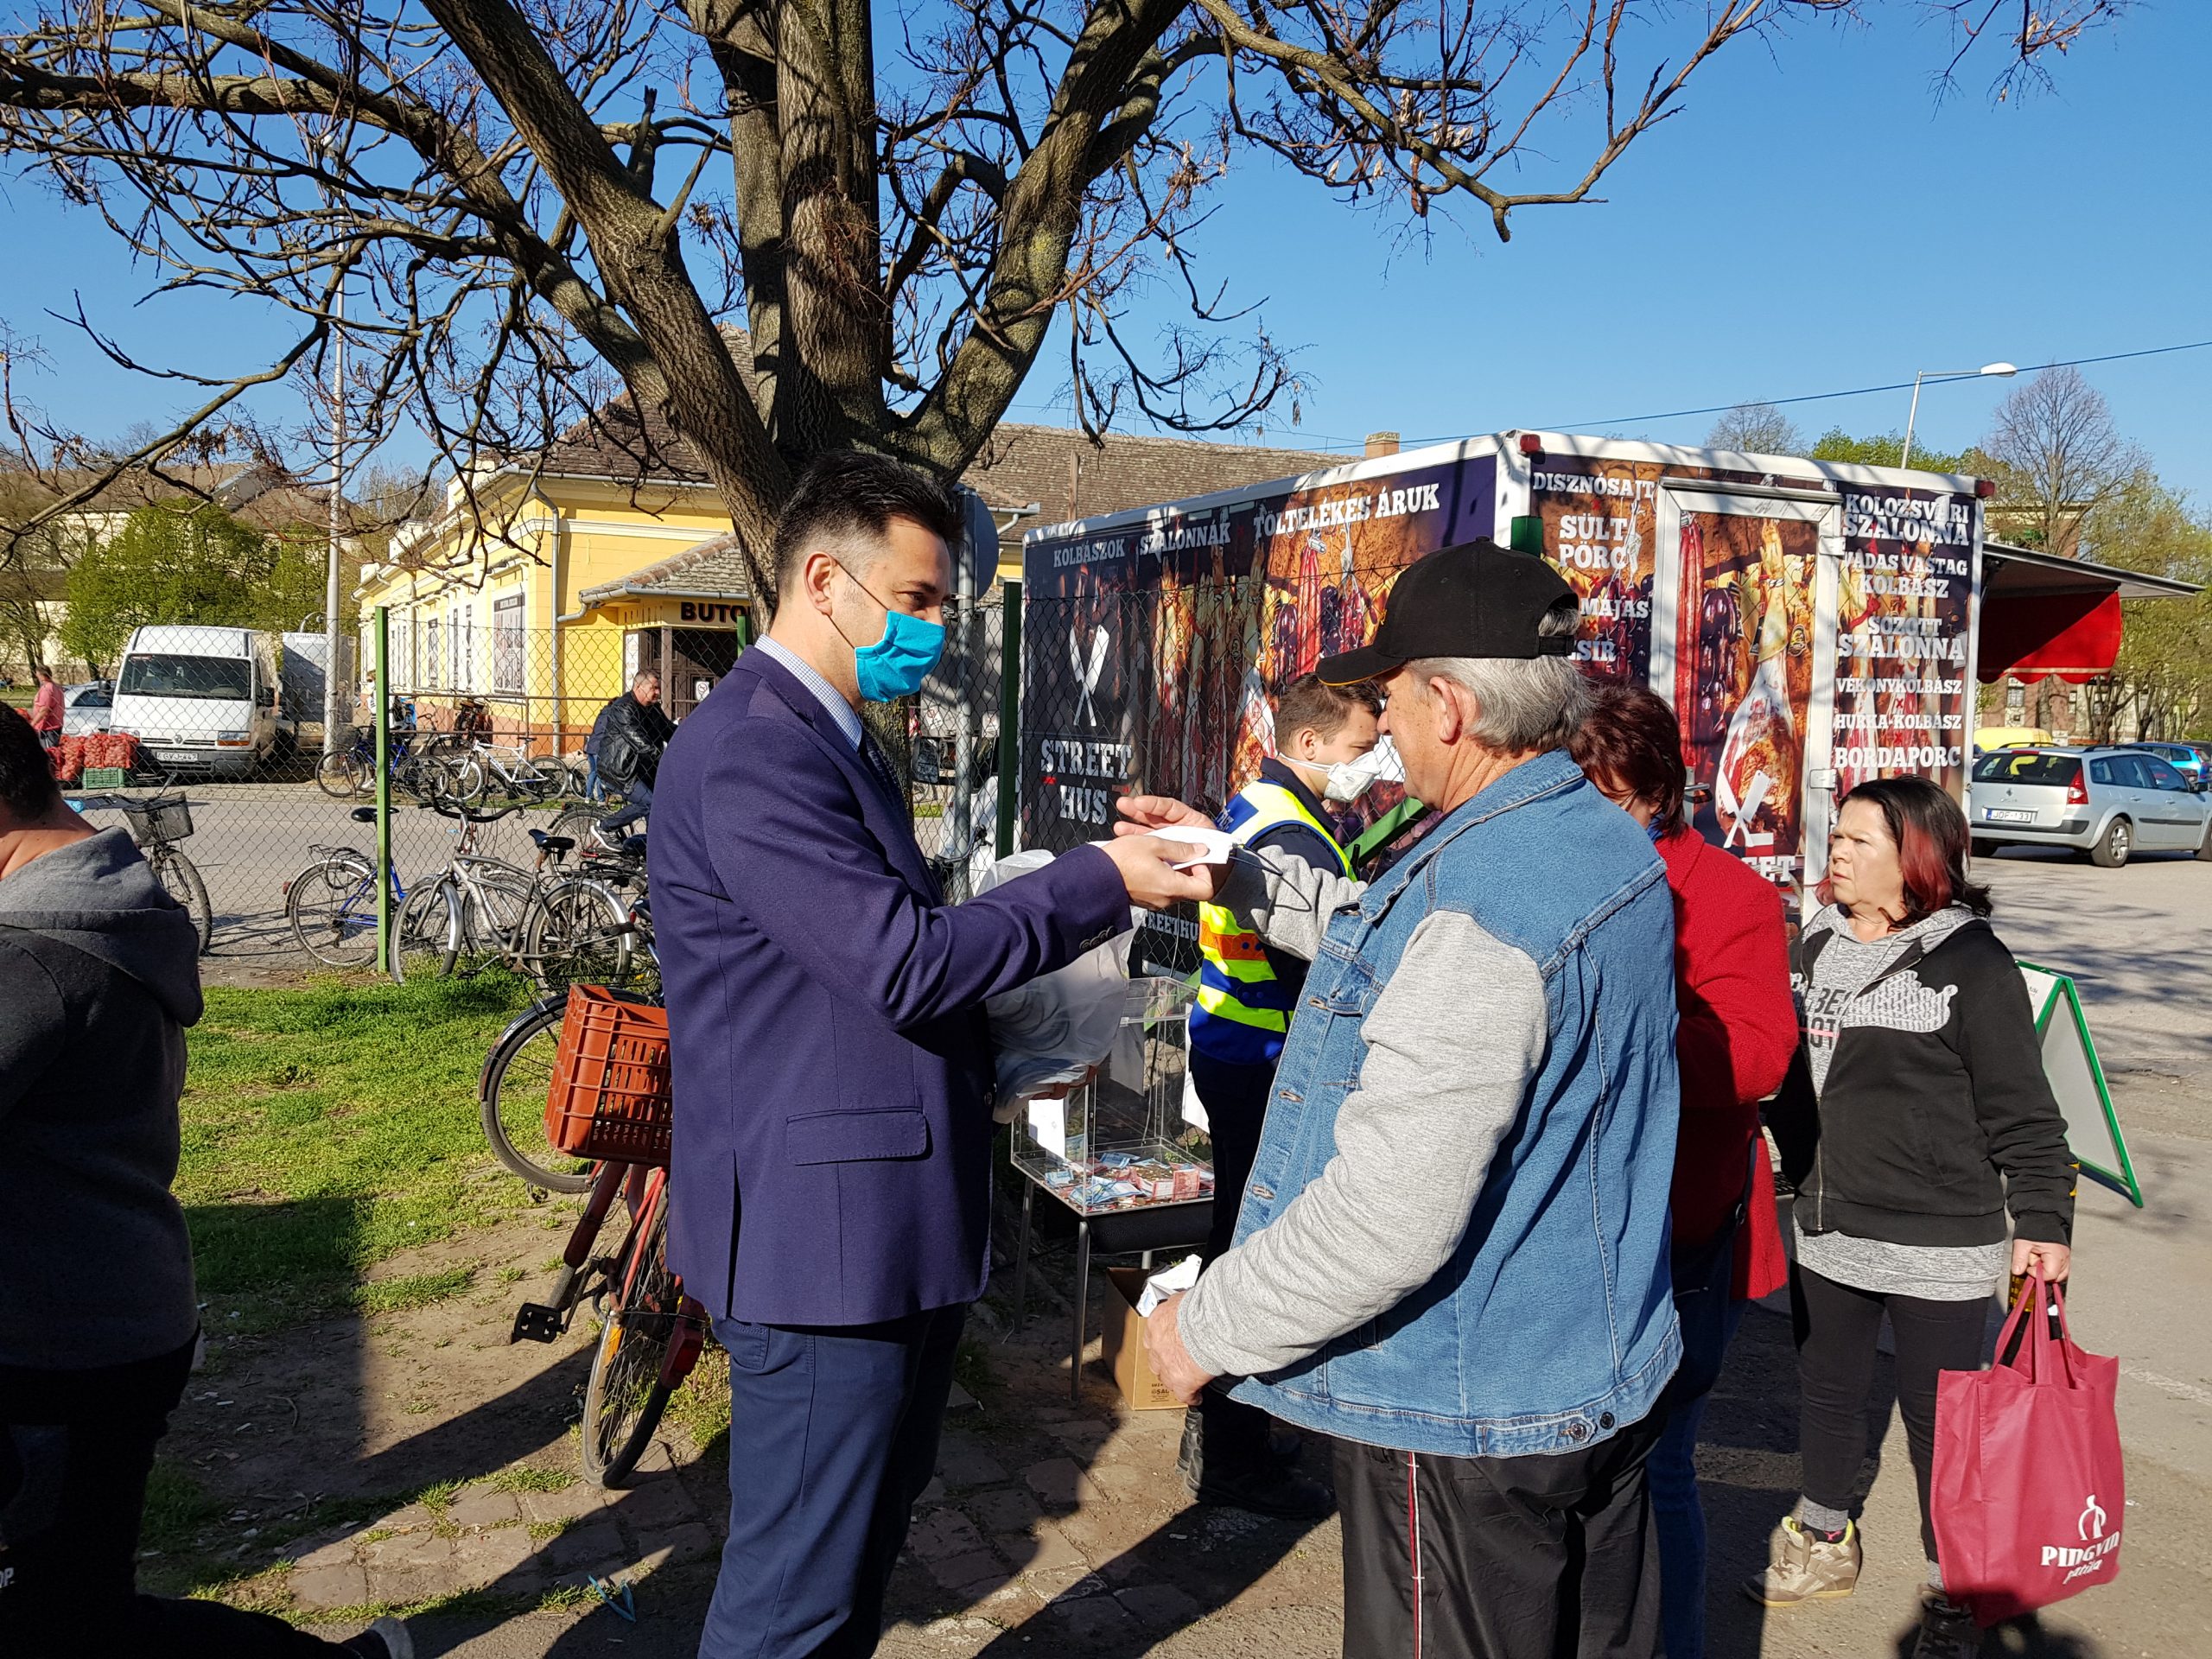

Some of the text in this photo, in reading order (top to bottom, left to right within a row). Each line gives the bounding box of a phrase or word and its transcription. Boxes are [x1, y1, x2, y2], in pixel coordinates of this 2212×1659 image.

[1533, 472, 1655, 501] DISZNÓSAJT
[1053, 483, 1440, 568] KOLBÁSZOK SZALONNÁK TÖLTELÉKES ÁRUK
[1560, 513, 1627, 541] SÜLT
[1842, 514, 1969, 546] SZALONNA
[1559, 541, 1628, 569] PÖRC
[1845, 550, 1967, 576] VADAS VASTAG
[681, 601, 751, 623] BUTO
[1839, 633, 1965, 660] SZALONNA
[1836, 674, 1962, 694] VÉKONYKOLBÁSZ
[1834, 711, 1962, 730] HURKA-KOLBÁSZ
[1041, 739, 1132, 779] STREET
[1834, 746, 1961, 768] BORDAPORC
[1059, 779, 1107, 824] HÚS
